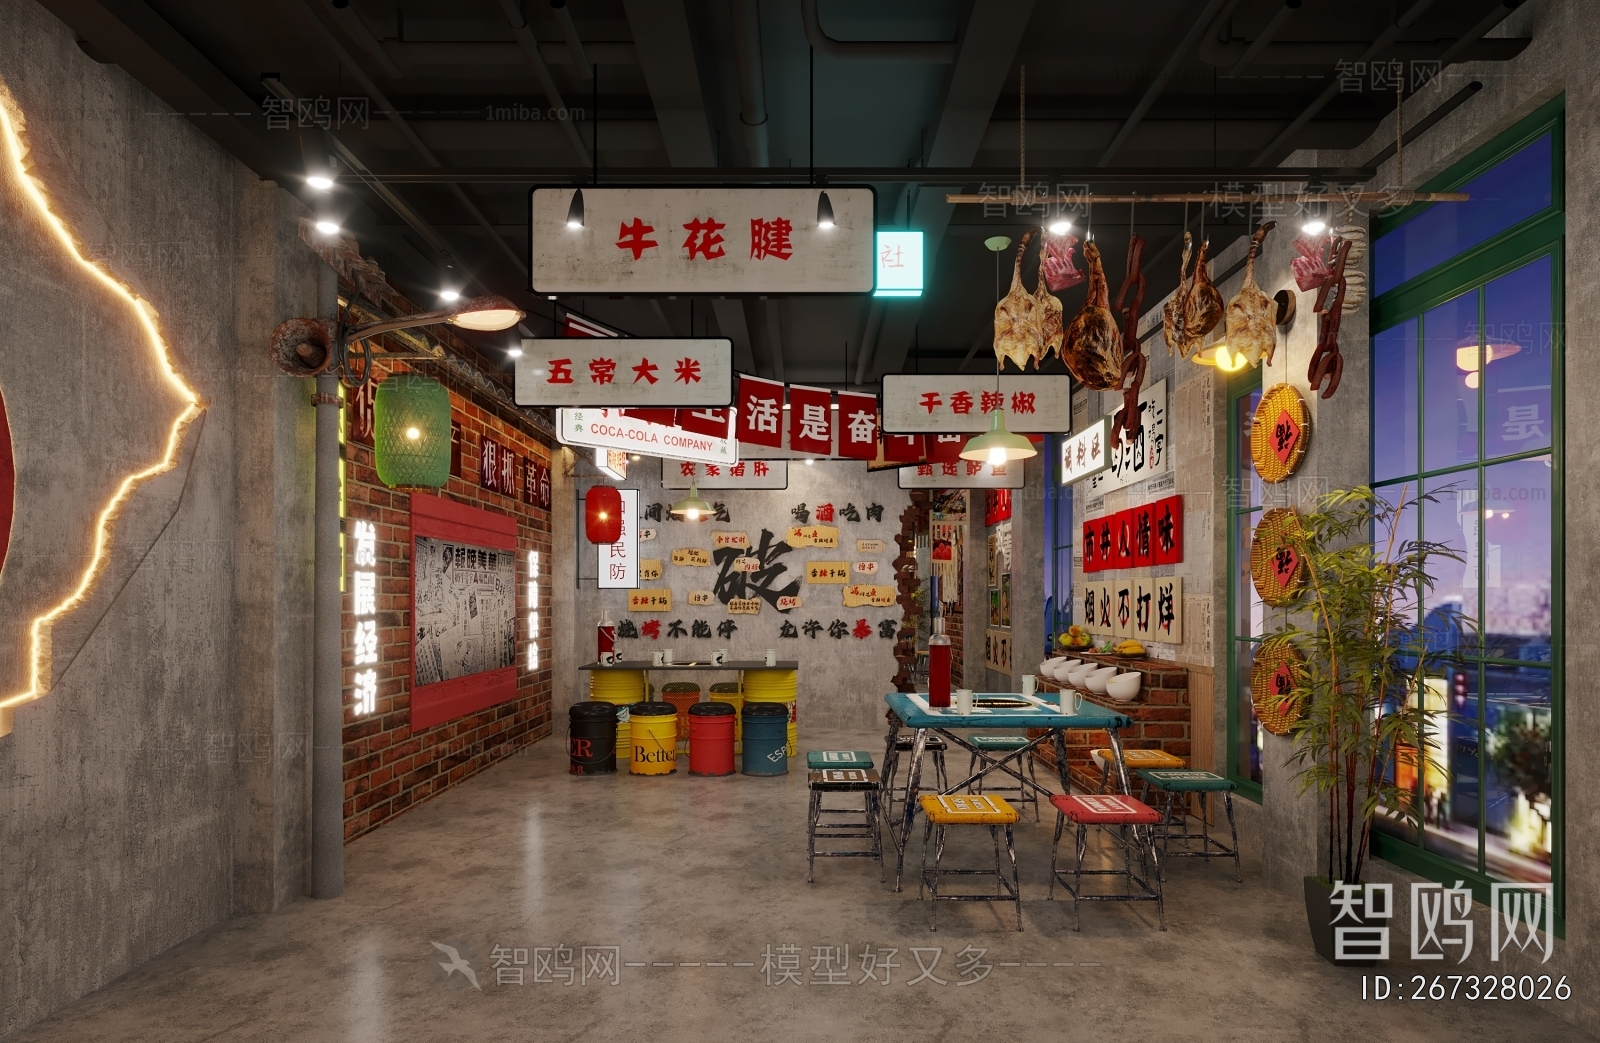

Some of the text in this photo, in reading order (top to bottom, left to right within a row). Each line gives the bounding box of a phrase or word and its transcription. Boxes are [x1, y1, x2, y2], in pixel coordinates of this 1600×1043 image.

[614, 216, 794, 262] 牛花腱
[880, 244, 905, 269] 社
[546, 356, 703, 386] 五常大米
[918, 390, 1037, 416] 干香辣椒
[573, 411, 585, 433] 经典
[1275, 419, 1293, 453] 福
[590, 422, 714, 453] COCA-COLA COMPANY
[679, 460, 770, 478] 农家猪肝
[790, 502, 885, 524] 喝酒吃肉
[1084, 503, 1175, 568] 市井人情味
[353, 520, 378, 716] 发展经济
[1084, 582, 1175, 636] 烟火不打烊
[617, 618, 738, 640] 烧烤不能停
[778, 617, 898, 640] 允许你暴富
